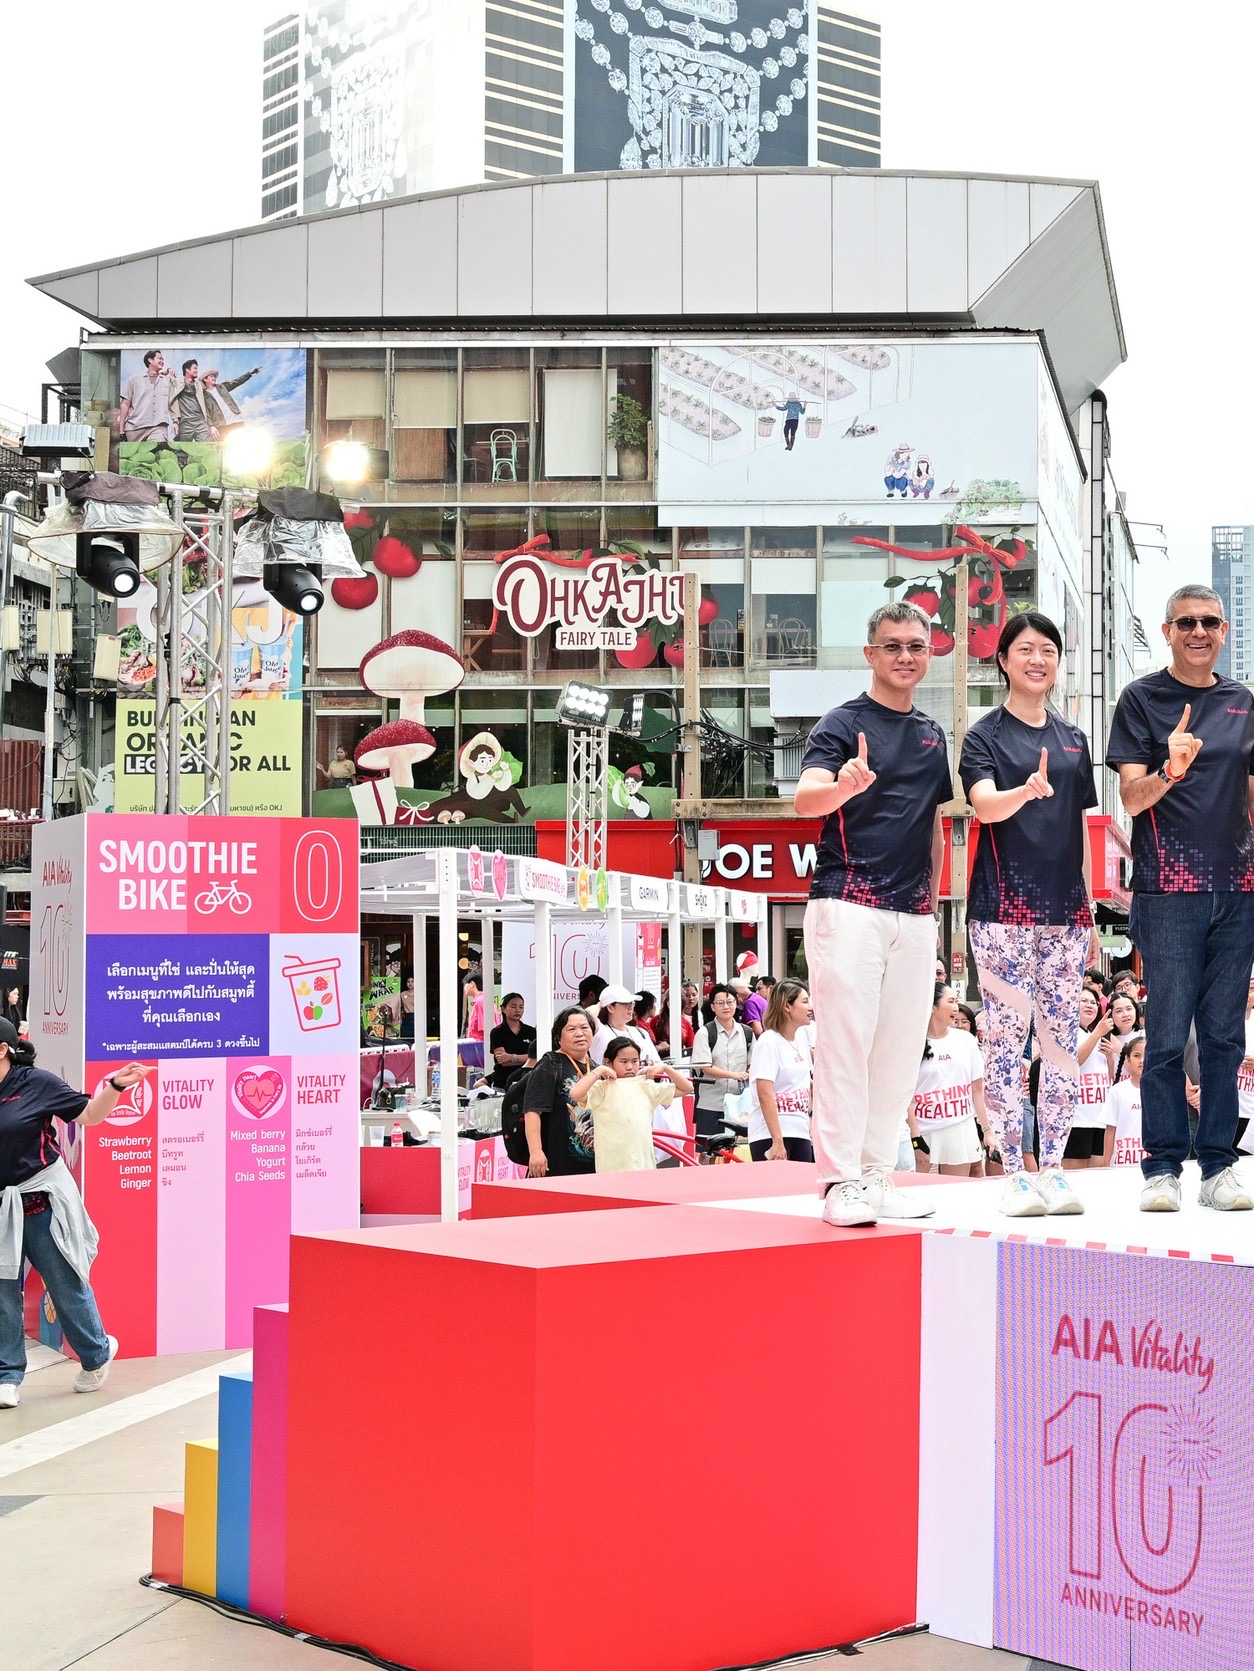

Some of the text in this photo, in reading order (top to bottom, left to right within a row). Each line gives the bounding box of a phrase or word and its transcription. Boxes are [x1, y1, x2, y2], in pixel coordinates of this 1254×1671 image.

[560, 631, 632, 646] FAIRY TALE
[257, 755, 291, 771] ALL
[269, 804, 283, 812] OKJ
[99, 839, 258, 875] SMOOTHIE
[702, 843, 773, 879] OE
[293, 829, 343, 922] 0
[118, 879, 188, 911] BIKE
[638, 886, 659, 901] GARMIN
[107, 958, 255, 981] เลือกเมนูที่ใช่ และปั่นให้สุด
[107, 980, 256, 1004] พร้อมสุขภาพดีไปกับสมูทตี้
[142, 1006, 221, 1028] ที่คุณเลือกเอง
[216, 1040, 222, 1048] 3
[224, 1035, 260, 1048] ดวงขึ้นไป
[938, 1054, 952, 1062] AIA
[162, 1079, 215, 1093] VITALITY
[297, 1074, 346, 1090] VITALITY
[162, 1094, 203, 1110] GLOW
[297, 1089, 341, 1105] HEART
[99, 1135, 152, 1149] Strawberry
[230, 1129, 286, 1141] Mixed berry
[111, 1149, 152, 1161] Beetroot
[251, 1143, 286, 1154] Banana
[119, 1163, 152, 1175] Lemon
[256, 1156, 286, 1168] Yogurt
[120, 1177, 152, 1190] Ginger
[235, 1170, 286, 1182] Chia Seeds
[1051, 1314, 1215, 1394] AIA Vitality
[1043, 1391, 1204, 1596] 10
[1060, 1583, 1205, 1637] ANNIVERSARY
